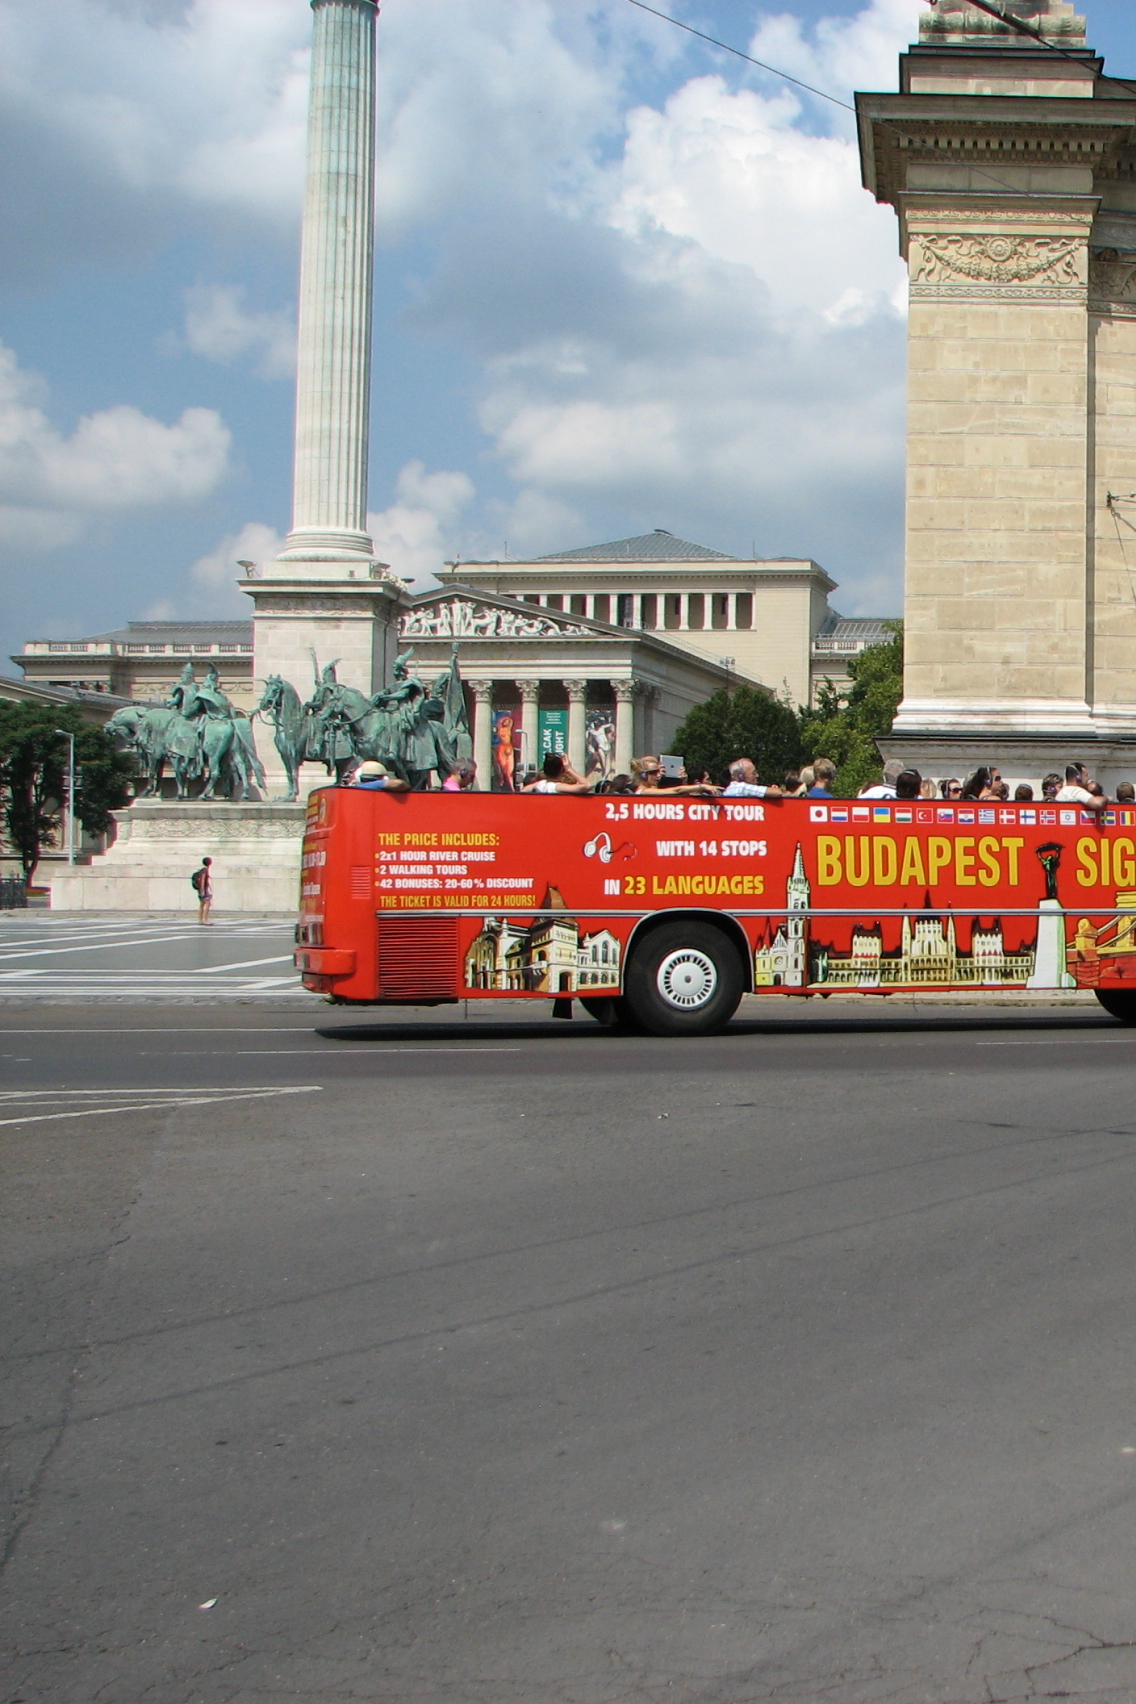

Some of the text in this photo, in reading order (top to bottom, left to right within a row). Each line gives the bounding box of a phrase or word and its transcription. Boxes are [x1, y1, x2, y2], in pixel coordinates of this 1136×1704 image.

[605, 803, 765, 821] 2,5 HOURS CITY TOUR
[378, 833, 500, 846] THE PRICE INCLUDES:
[656, 840, 767, 856] WITH 14 STOPS
[400, 851, 427, 861] HOUR
[429, 851, 459, 861] RIVER
[461, 851, 496, 861] CRUISE
[816, 835, 1025, 887] BUDAPEST
[379, 865, 468, 875] 2 WALKING TOURS
[379, 878, 392, 889] 42
[395, 878, 443, 889] BONUSES:
[486, 878, 534, 888] DISCOUNT
[604, 875, 765, 895] IN 23 LANGUAGES
[380, 894, 536, 907] THE TICKET IS VALID FOR 24 HOURS!
